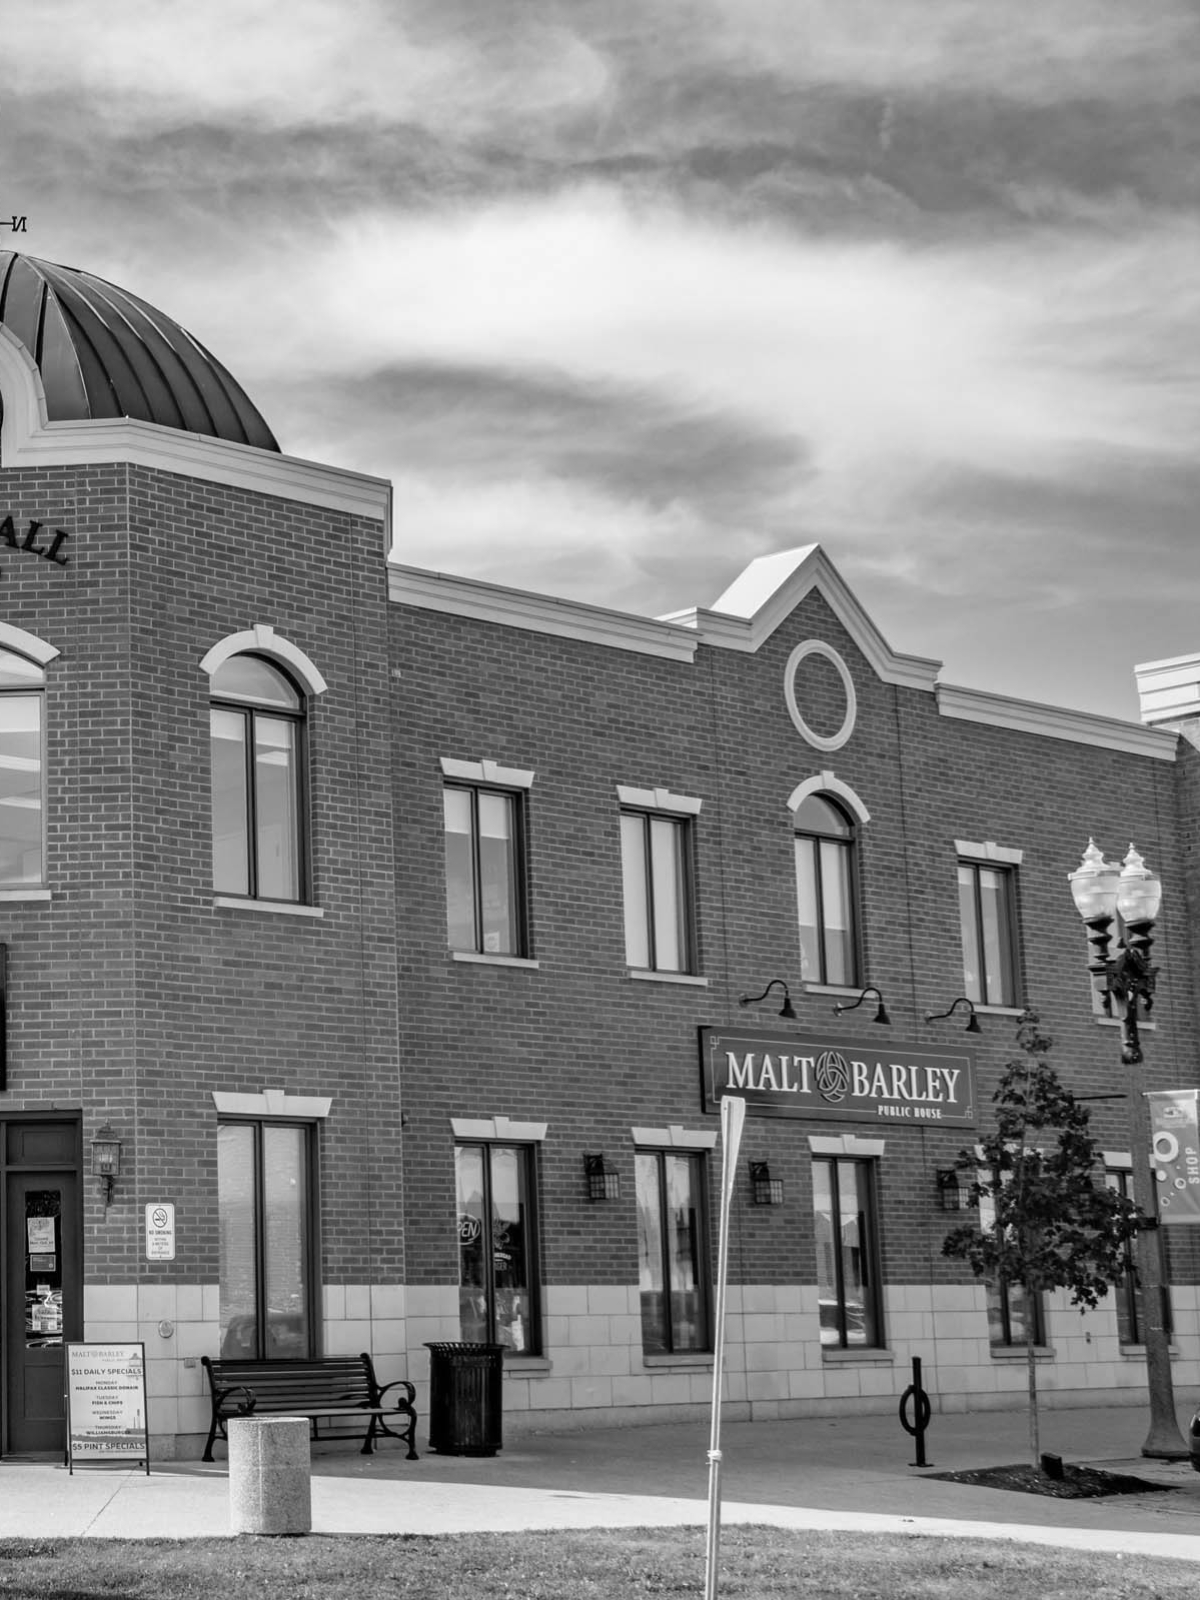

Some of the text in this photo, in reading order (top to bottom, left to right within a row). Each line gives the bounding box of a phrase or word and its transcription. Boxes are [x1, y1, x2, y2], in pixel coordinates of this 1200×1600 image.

[726, 1052, 961, 1103] MALT BARLEY
[878, 1105, 942, 1119] PUBLIC HOUSE
[1185, 1147, 1200, 1185] SHOP
[457, 1221, 477, 1237] PEN
[71, 1368, 83, 1376] $11
[72, 1441, 145, 1451] $5 PINT SPECIALS
